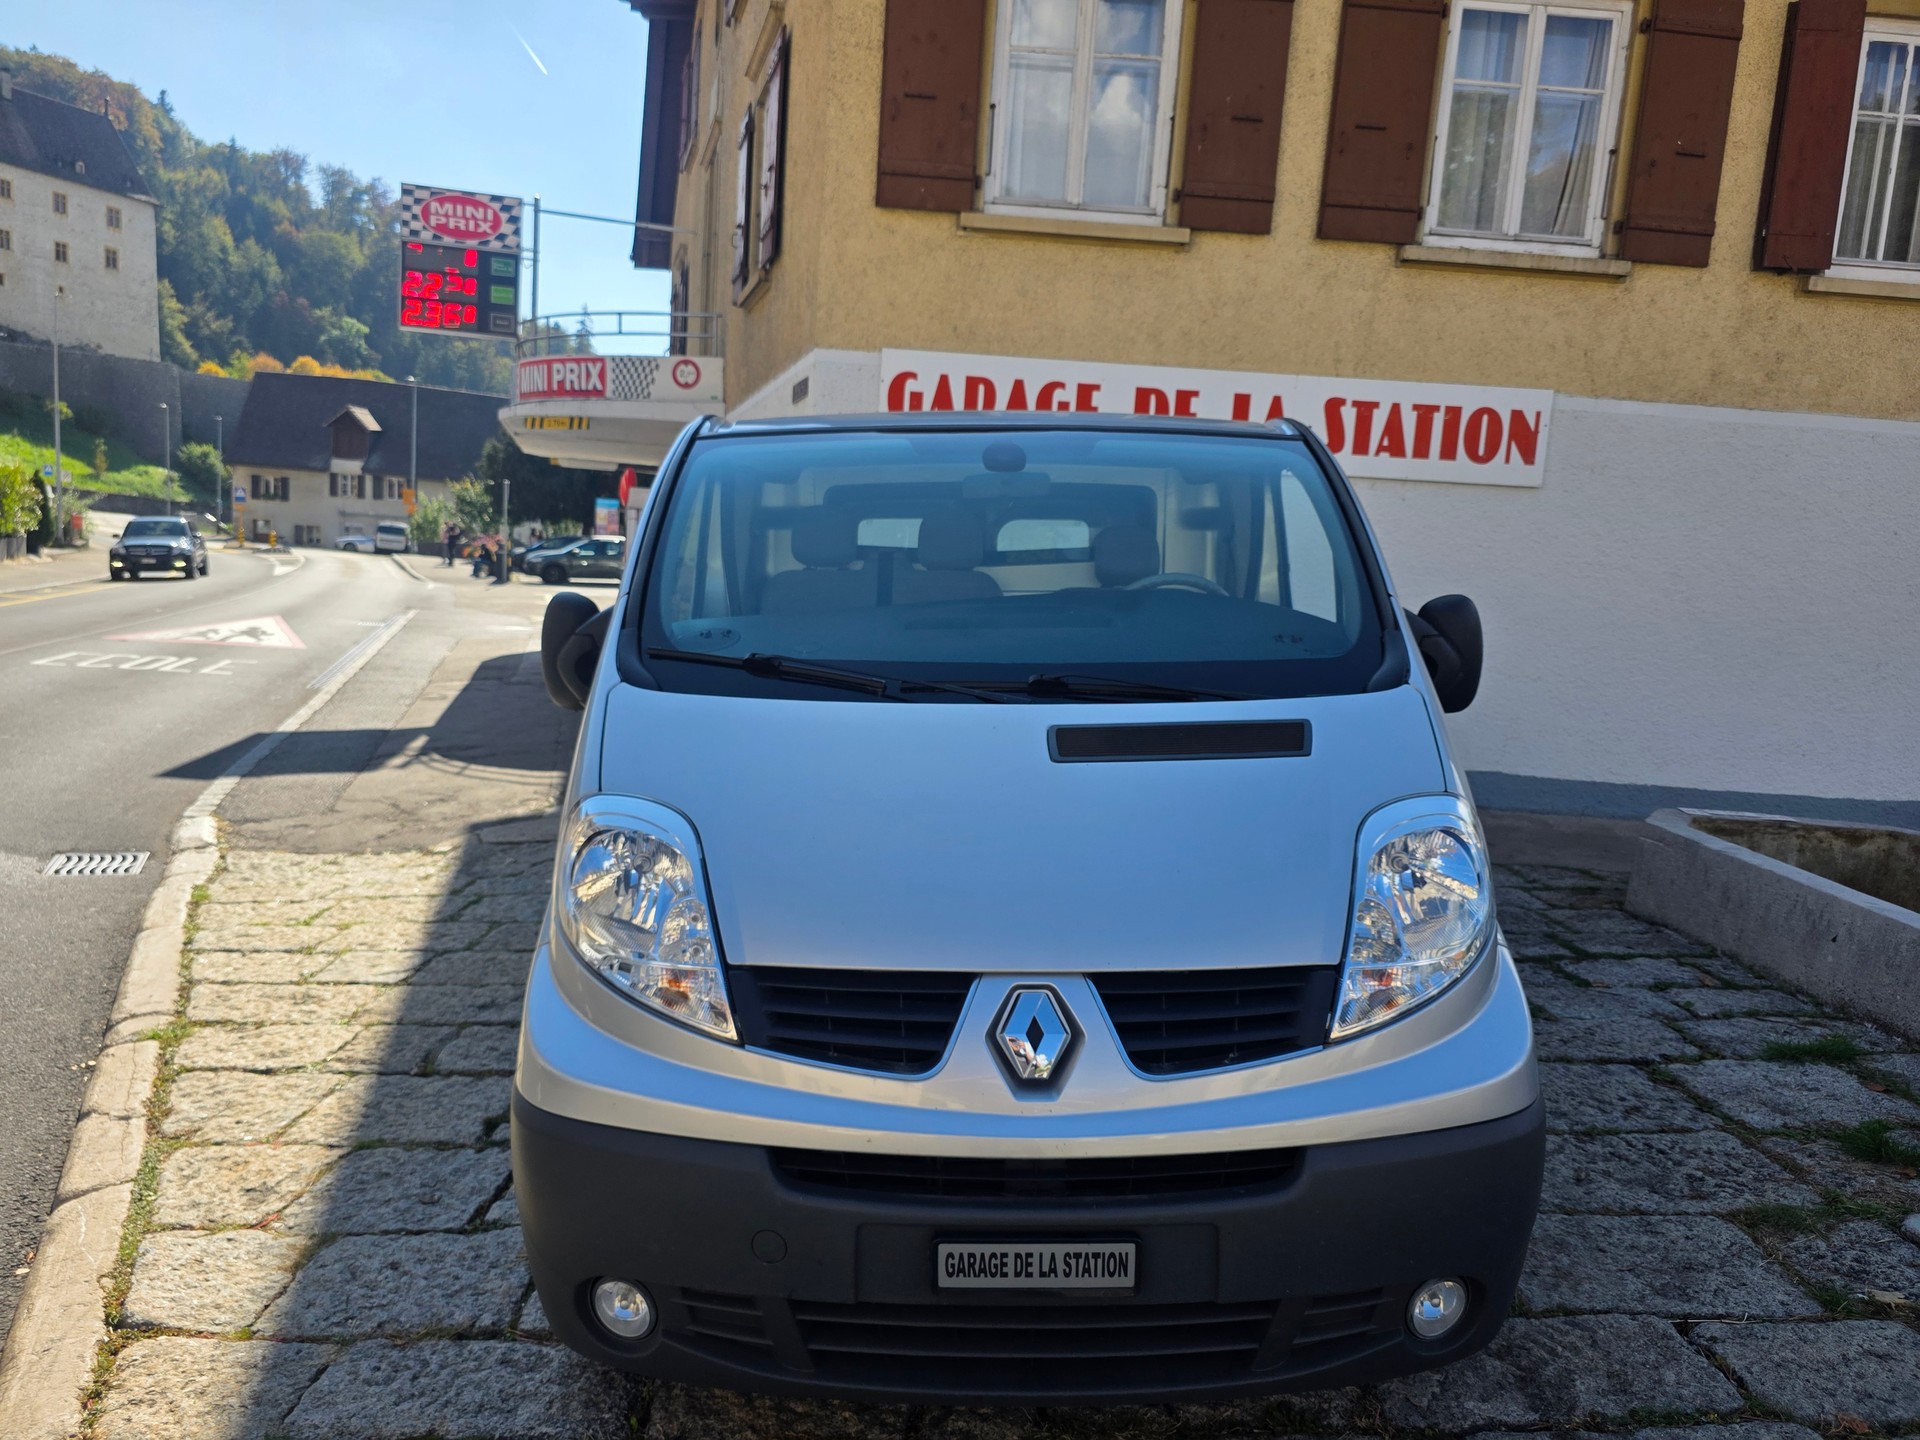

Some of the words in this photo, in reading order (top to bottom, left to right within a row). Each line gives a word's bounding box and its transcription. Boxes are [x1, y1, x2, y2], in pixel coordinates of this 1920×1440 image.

[429, 201, 494, 221] MINI
[429, 215, 495, 235] PRIX
[521, 364, 548, 393] MINI
[552, 361, 604, 391] PRIX
[1323, 396, 1541, 466] STATION
[29, 651, 258, 676] ECOLE
[945, 1252, 1008, 1278] GARAGE
[1014, 1252, 1034, 1278] DE
[1039, 1252, 1058, 1278] LA
[1063, 1252, 1129, 1278] STATION
